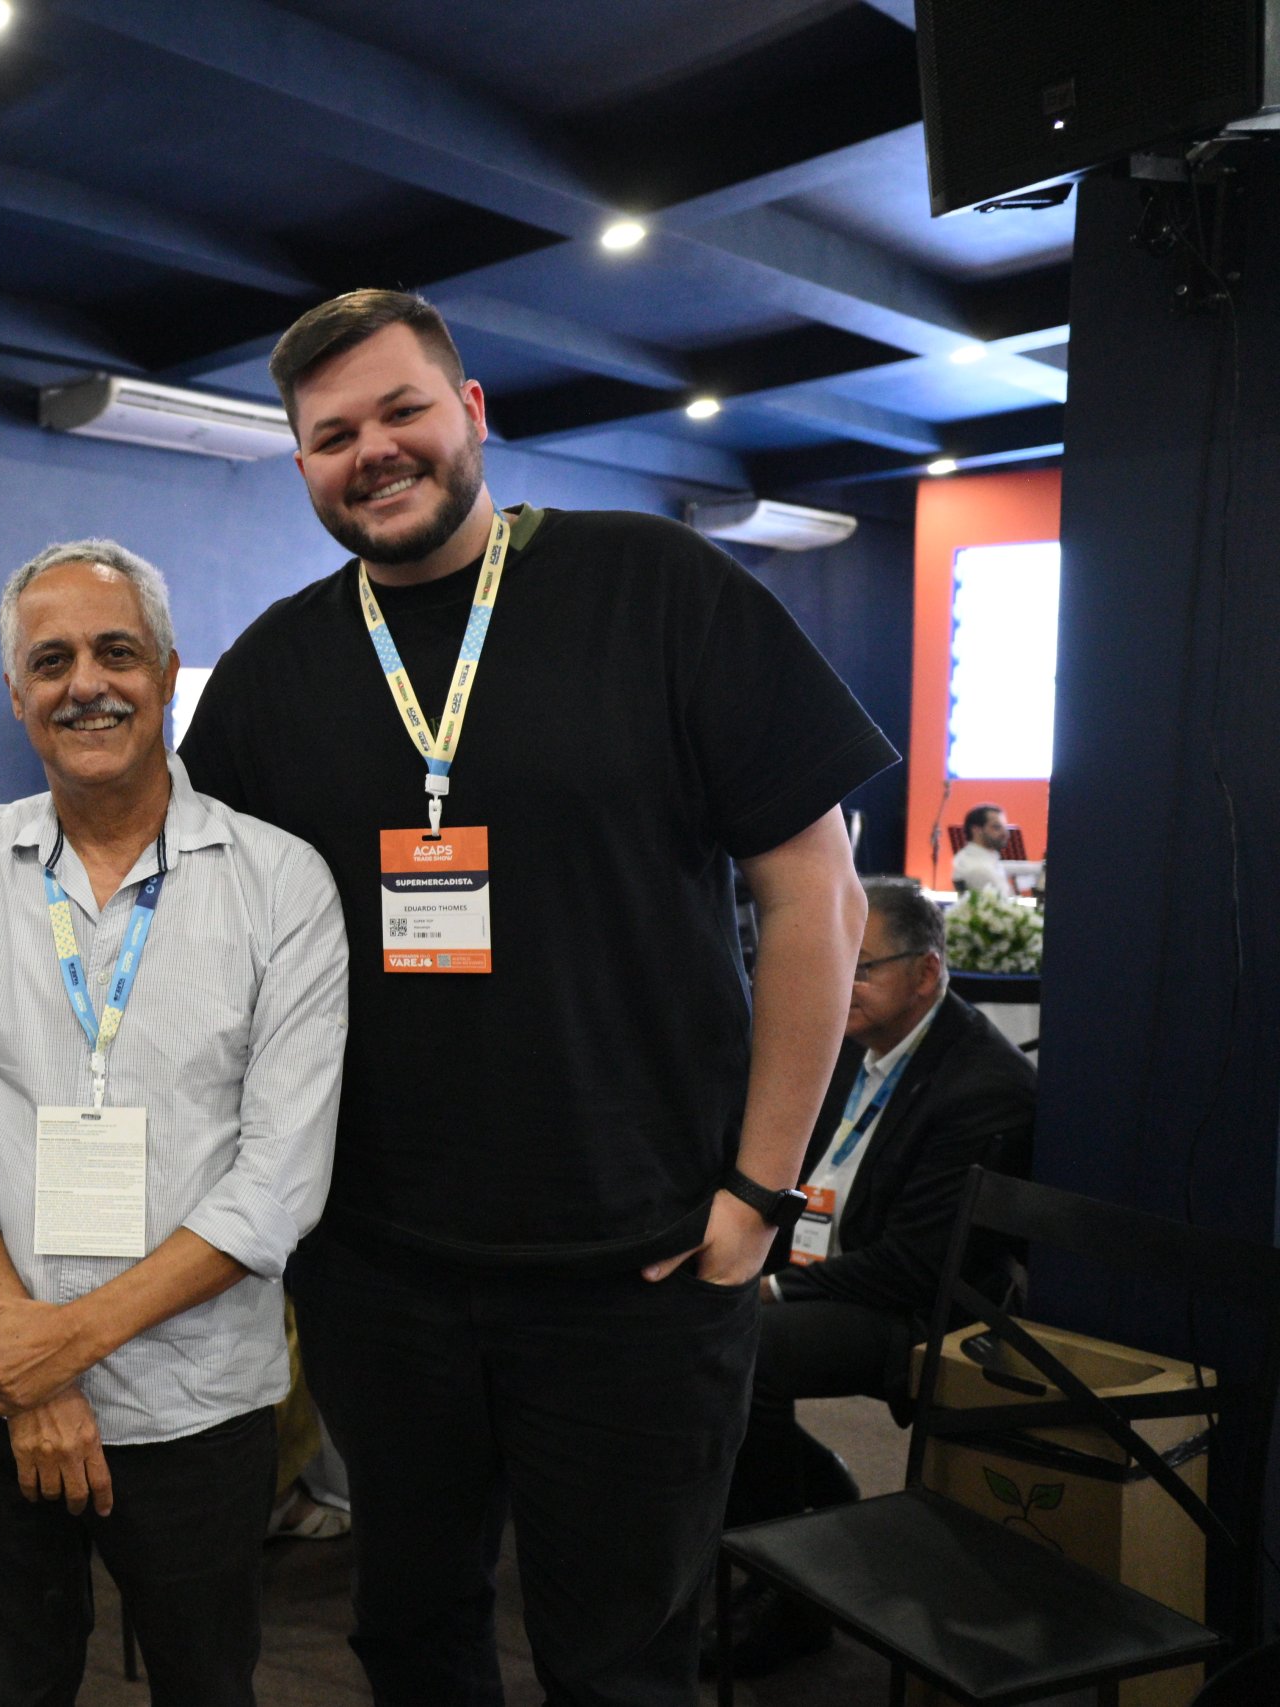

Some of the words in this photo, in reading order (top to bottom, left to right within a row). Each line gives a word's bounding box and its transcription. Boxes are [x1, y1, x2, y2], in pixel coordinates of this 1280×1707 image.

[488, 543, 499, 564] ACAPS
[451, 692, 461, 714] ACAPS
[407, 706, 420, 726] ACAPS
[414, 845, 453, 856] ACAPS
[395, 878, 473, 887] SUPERMERCADISTA
[389, 958, 433, 967] VAREJO
